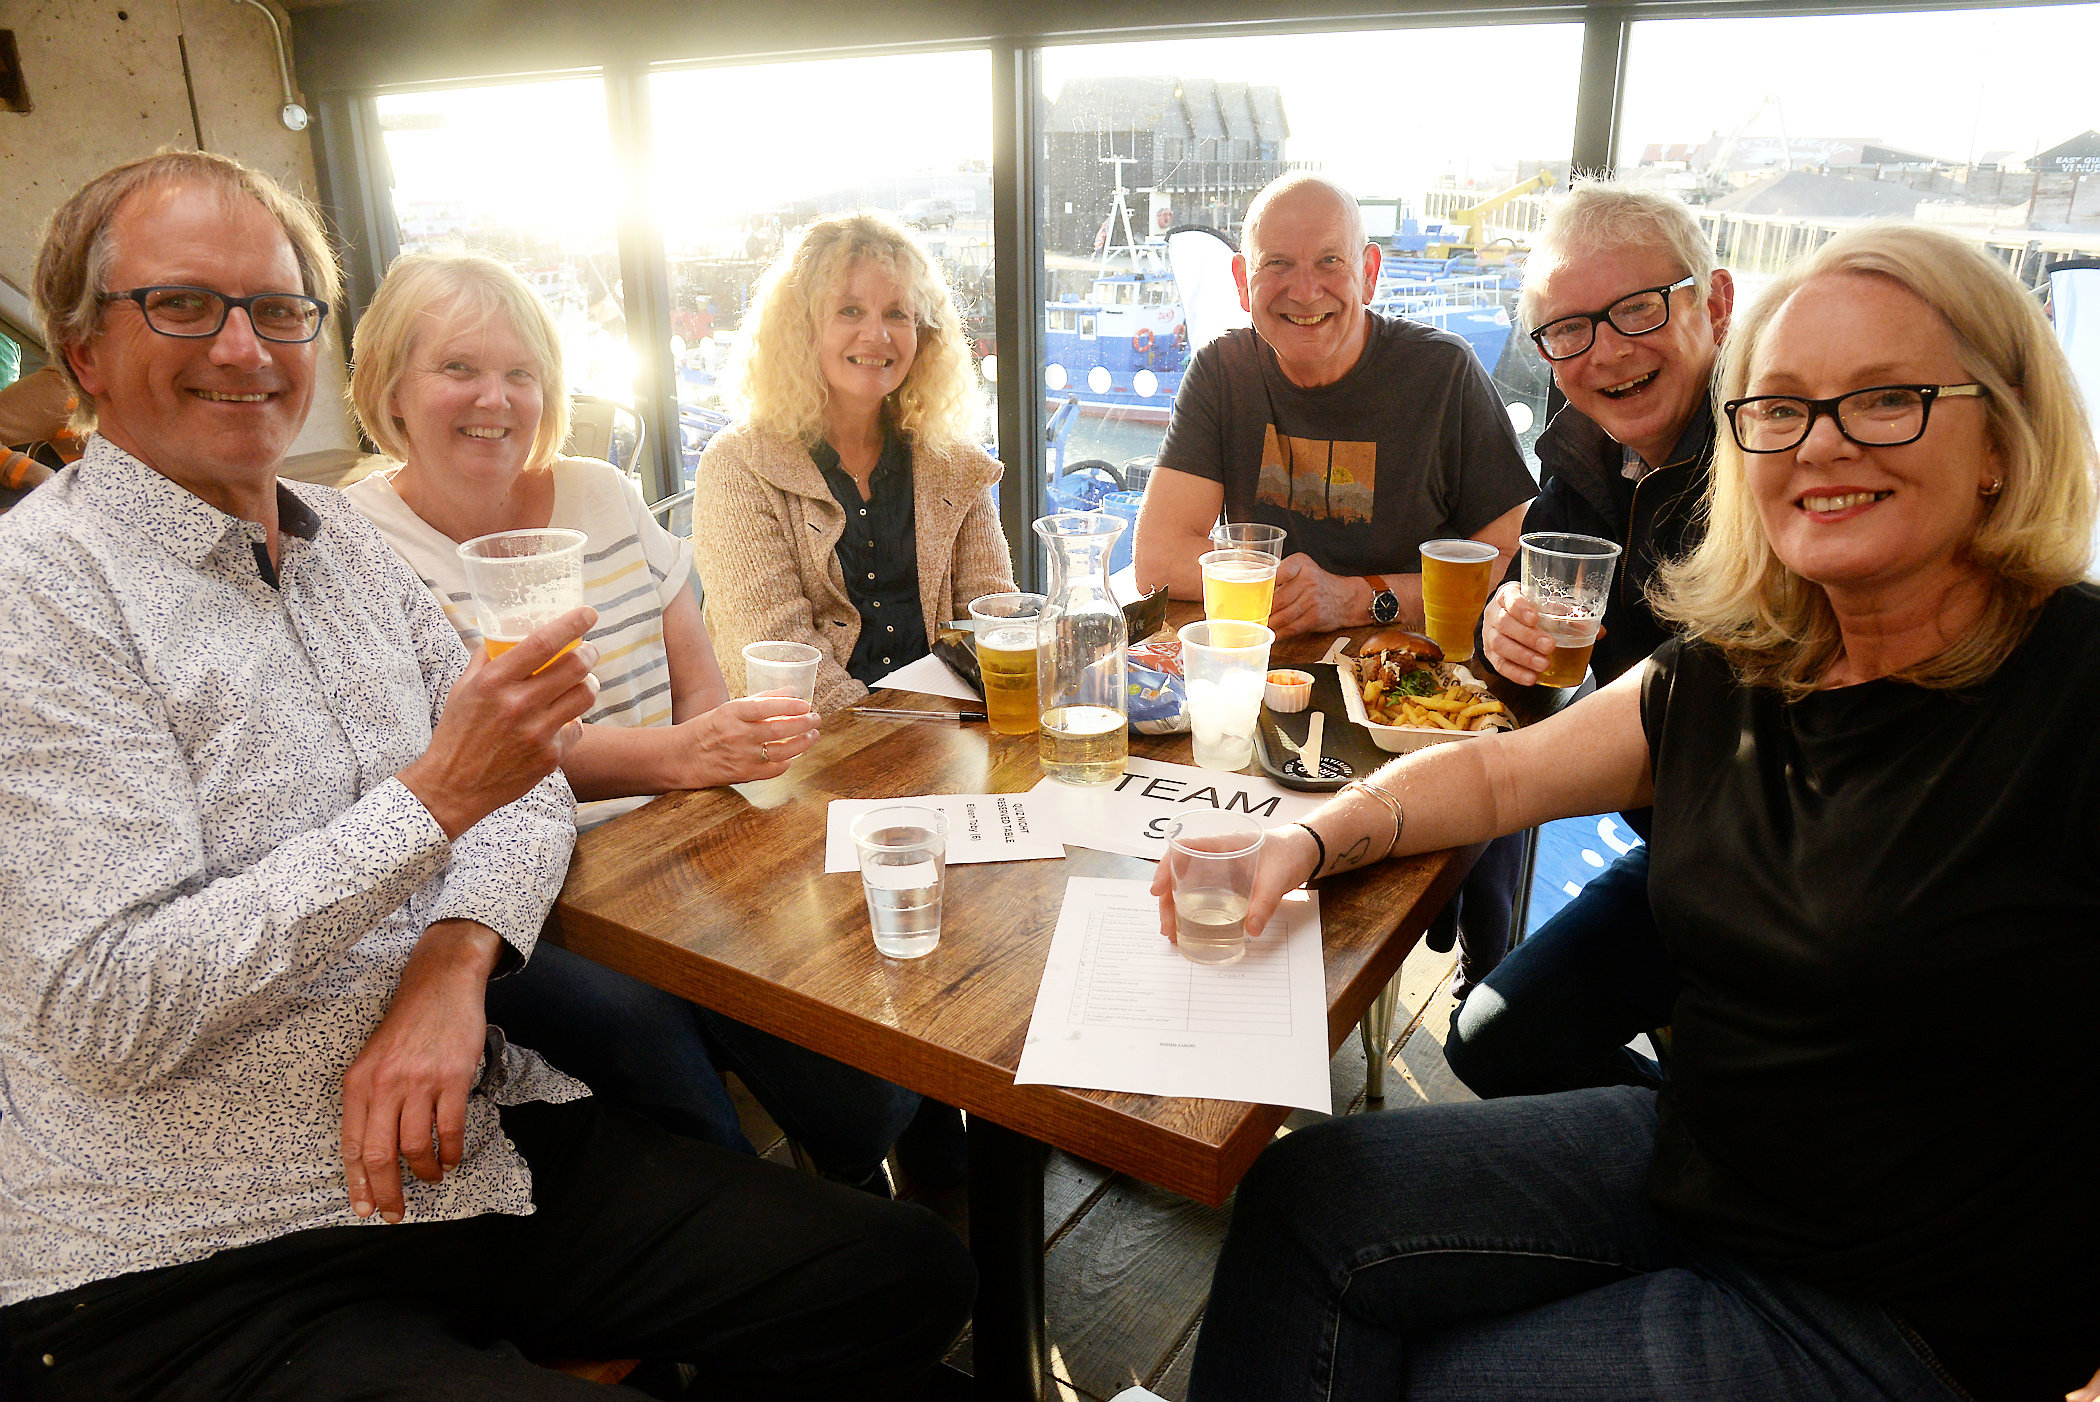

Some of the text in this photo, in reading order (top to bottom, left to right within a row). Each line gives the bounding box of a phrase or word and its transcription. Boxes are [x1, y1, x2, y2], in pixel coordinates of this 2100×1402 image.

[2055, 156, 2100, 164] EAST QU
[1113, 772, 1282, 818] TEAM
[966, 803, 981, 841] Eileen Toby (6)
[996, 798, 1015, 843] RESERVED TABLE
[1012, 803, 1030, 834] QUIZ NIGHT
[1143, 817, 1184, 840] 9
